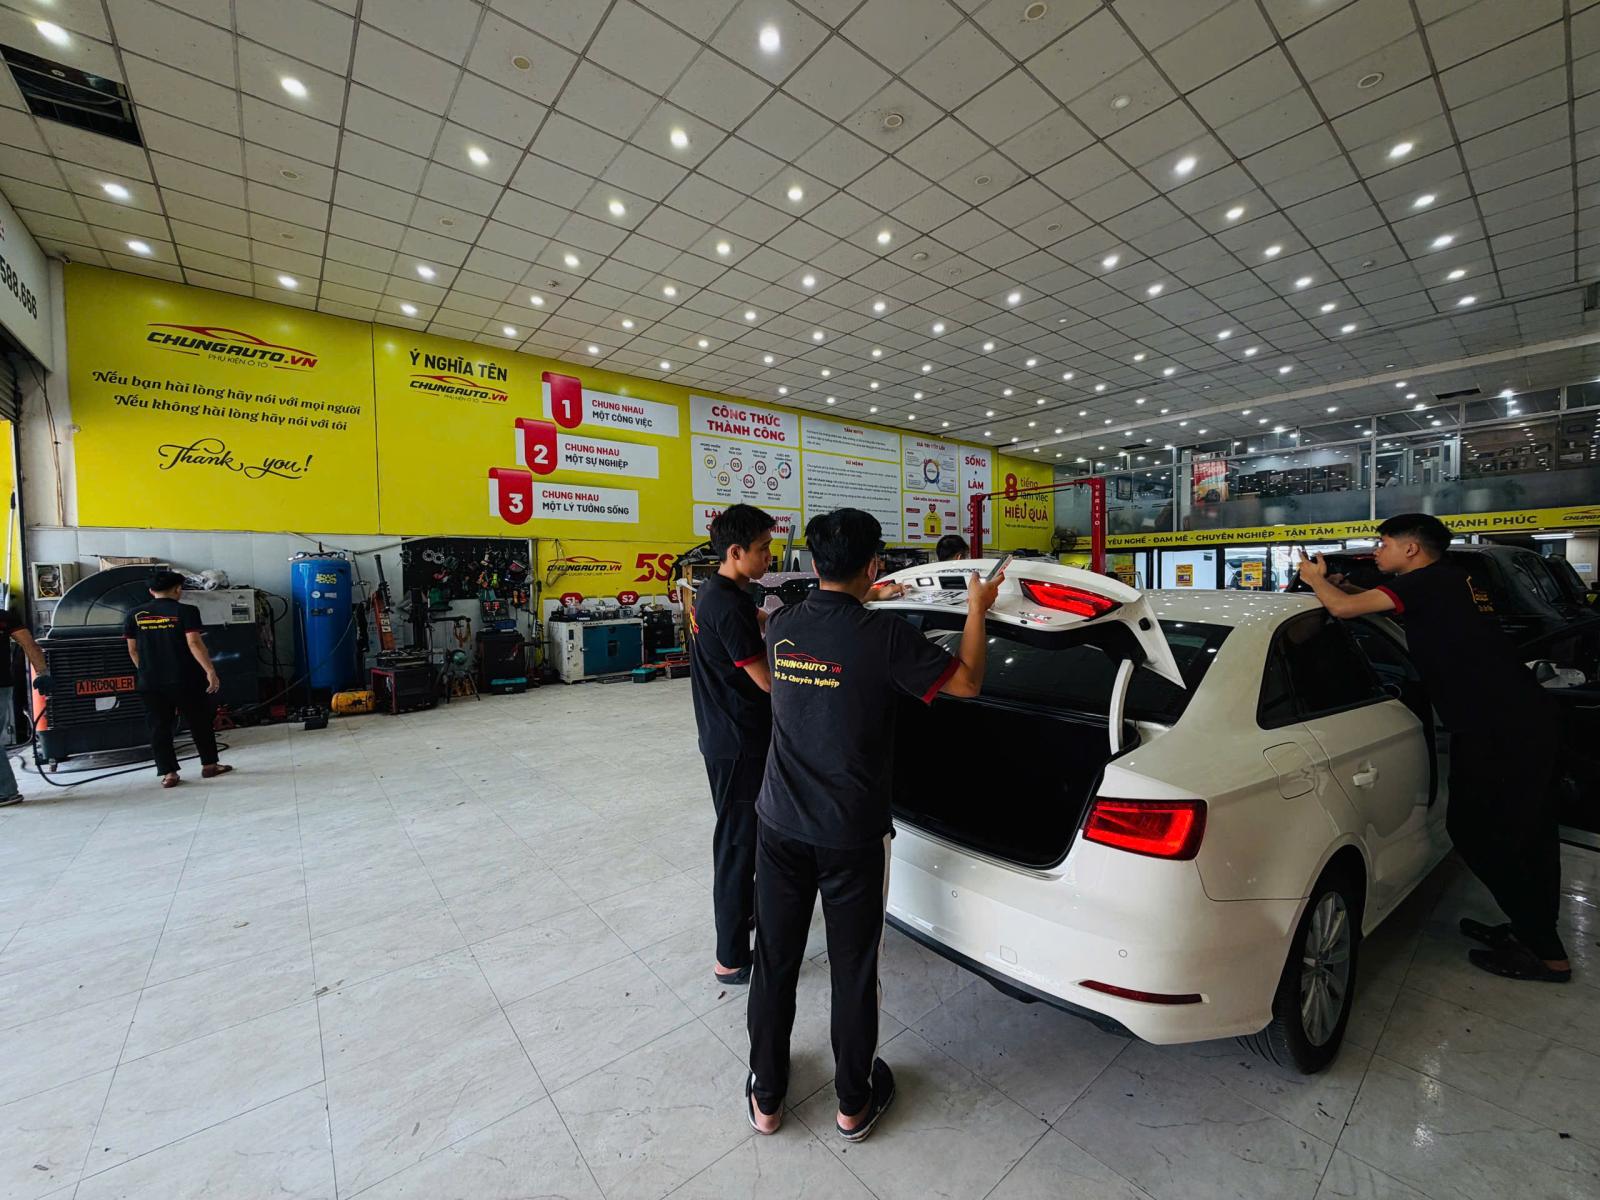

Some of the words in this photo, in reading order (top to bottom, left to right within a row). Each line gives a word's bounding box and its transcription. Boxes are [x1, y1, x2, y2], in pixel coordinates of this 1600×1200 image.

[147, 331, 318, 368] CHUNGAUTO.VN
[410, 348, 420, 366] Ý
[424, 354, 474, 376] NGHĨA
[478, 363, 508, 382] TÊN
[92, 371, 128, 385] Nếu
[131, 375, 161, 390] bạn
[165, 380, 190, 393] hài
[192, 383, 225, 399] lòng
[227, 388, 252, 402] hãy
[255, 393, 276, 405] nói
[279, 396, 298, 407] với
[301, 400, 325, 411] mọi
[327, 404, 361, 415] người
[409, 381, 508, 402] CHUNGAUTO.VN
[114, 394, 148, 408] Nếu
[152, 398, 200, 416] không
[202, 404, 226, 417] hài
[228, 407, 260, 422] lòng
[261, 411, 285, 425] hãy
[288, 416, 308, 426] nói
[310, 418, 329, 429] với
[331, 420, 347, 431] tôi
[562, 399, 571, 419] 1
[592, 399, 620, 411] CHUNG
[622, 404, 644, 415] NHAU
[711, 405, 747, 421] CÔNG
[749, 412, 781, 427] THỨC
[592, 410, 610, 421] MỘT
[611, 413, 633, 424] CÔNG
[635, 417, 653, 428] VIỆC
[707, 420, 750, 436] THÀNH
[753, 426, 785, 442] CÔNG
[158, 438, 244, 472] Thank
[533, 444, 549, 465] 2
[565, 442, 595, 454] CHUNG
[596, 447, 620, 457] NHAU
[565, 454, 584, 466] MỘT
[586, 456, 597, 467] SỰ
[599, 459, 629, 470] NGHIỆP
[965, 454, 987, 468] SỐNG
[542, 490, 573, 500] CHUNG
[575, 492, 599, 502] NHAU
[1005, 473, 1018, 501] 8
[508, 493, 524, 513] 3
[542, 501, 562, 513] MỘT
[563, 501, 575, 512] LÝ
[576, 502, 606, 514] TƯỞNG
[607, 504, 630, 515] SỐNG
[1004, 502, 1027, 522] HIỆU
[1492, 513, 1538, 526] PHÚC
[1107, 537, 1123, 546] YÊU
[1124, 535, 1146, 544] NGHỀ
[1175, 534, 1188, 542] MÊ
[1195, 532, 1234, 542] CHUYÊN
[1236, 530, 1275, 540] NGHIỆP
[1284, 528, 1307, 538] TẬN
[1309, 525, 1334, 536] TÂM
[1345, 523, 1378, 534] THÀN
[633, 553, 675, 582] 5S
[621, 594, 634, 603] S2
[78, 677, 133, 693] AIRCOOLER
